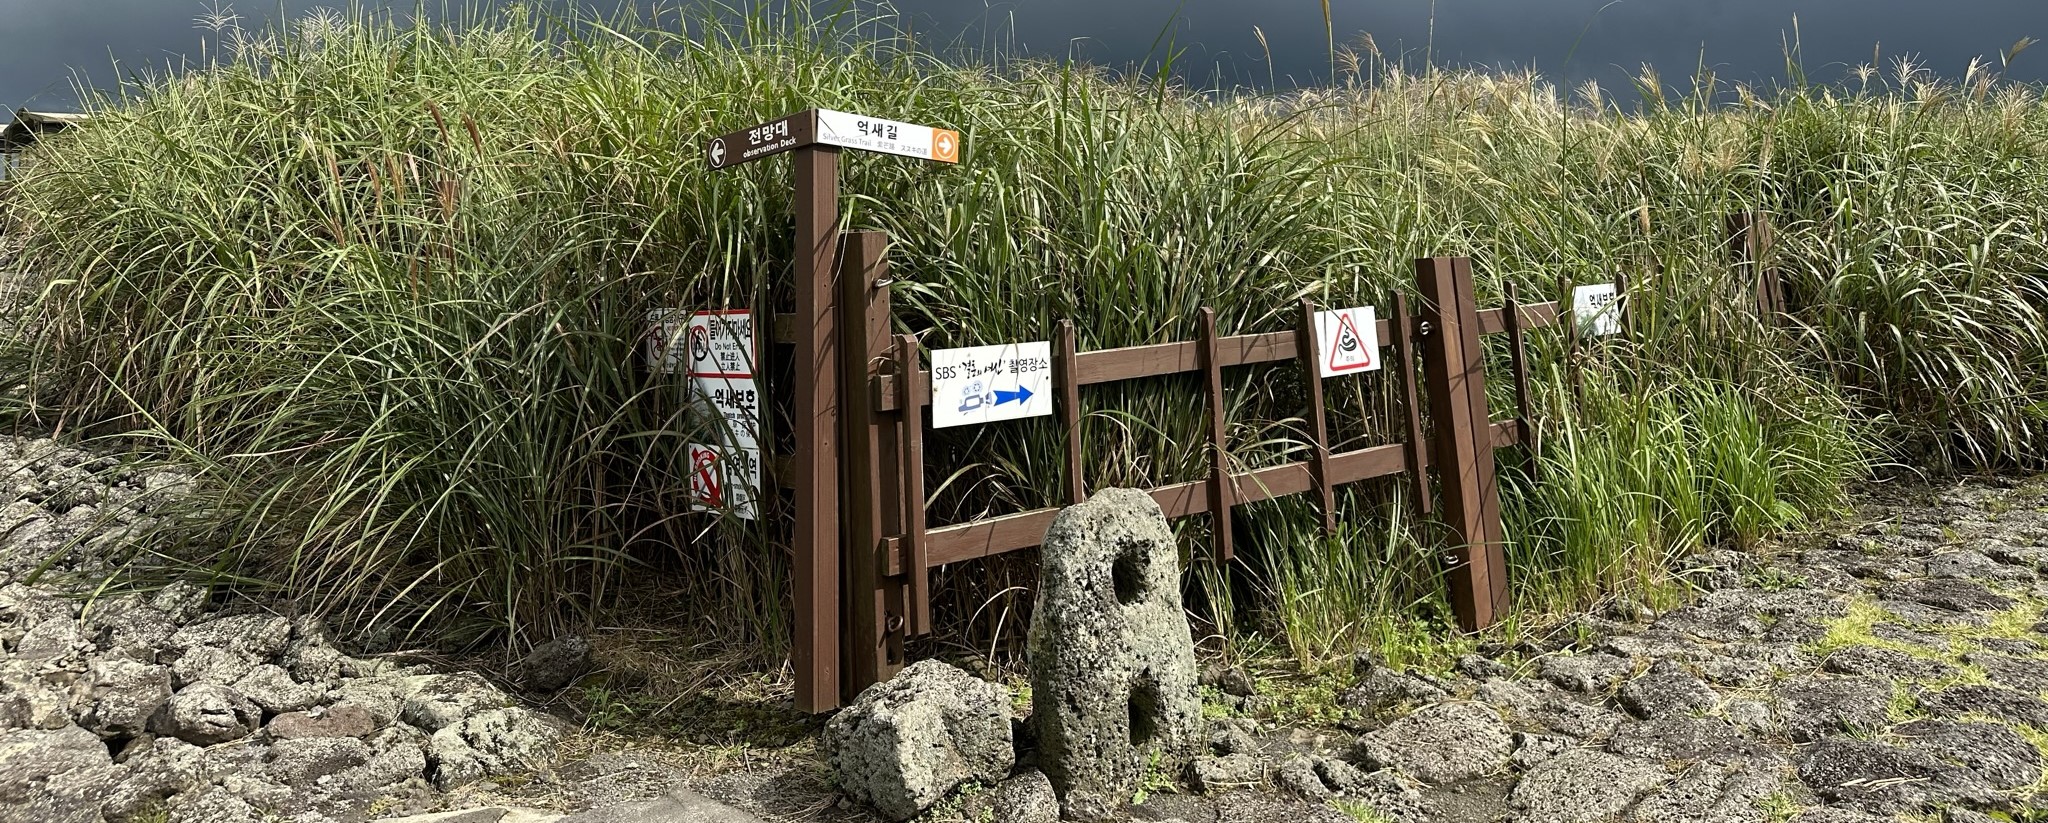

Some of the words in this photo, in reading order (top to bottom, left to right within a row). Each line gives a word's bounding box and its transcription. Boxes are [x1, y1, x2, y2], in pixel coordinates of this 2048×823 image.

[748, 119, 788, 145] 전망대
[822, 132, 840, 142] Silver
[840, 135, 858, 145] Grass
[859, 138, 872, 147] Trail
[743, 143, 779, 158] observation
[780, 136, 796, 148] Deck
[715, 342, 721, 351] Do
[723, 342, 732, 351] Not
[935, 365, 957, 380] SBS
[1008, 357, 1048, 374] 촬영장소
[715, 388, 756, 410] 억새보호
